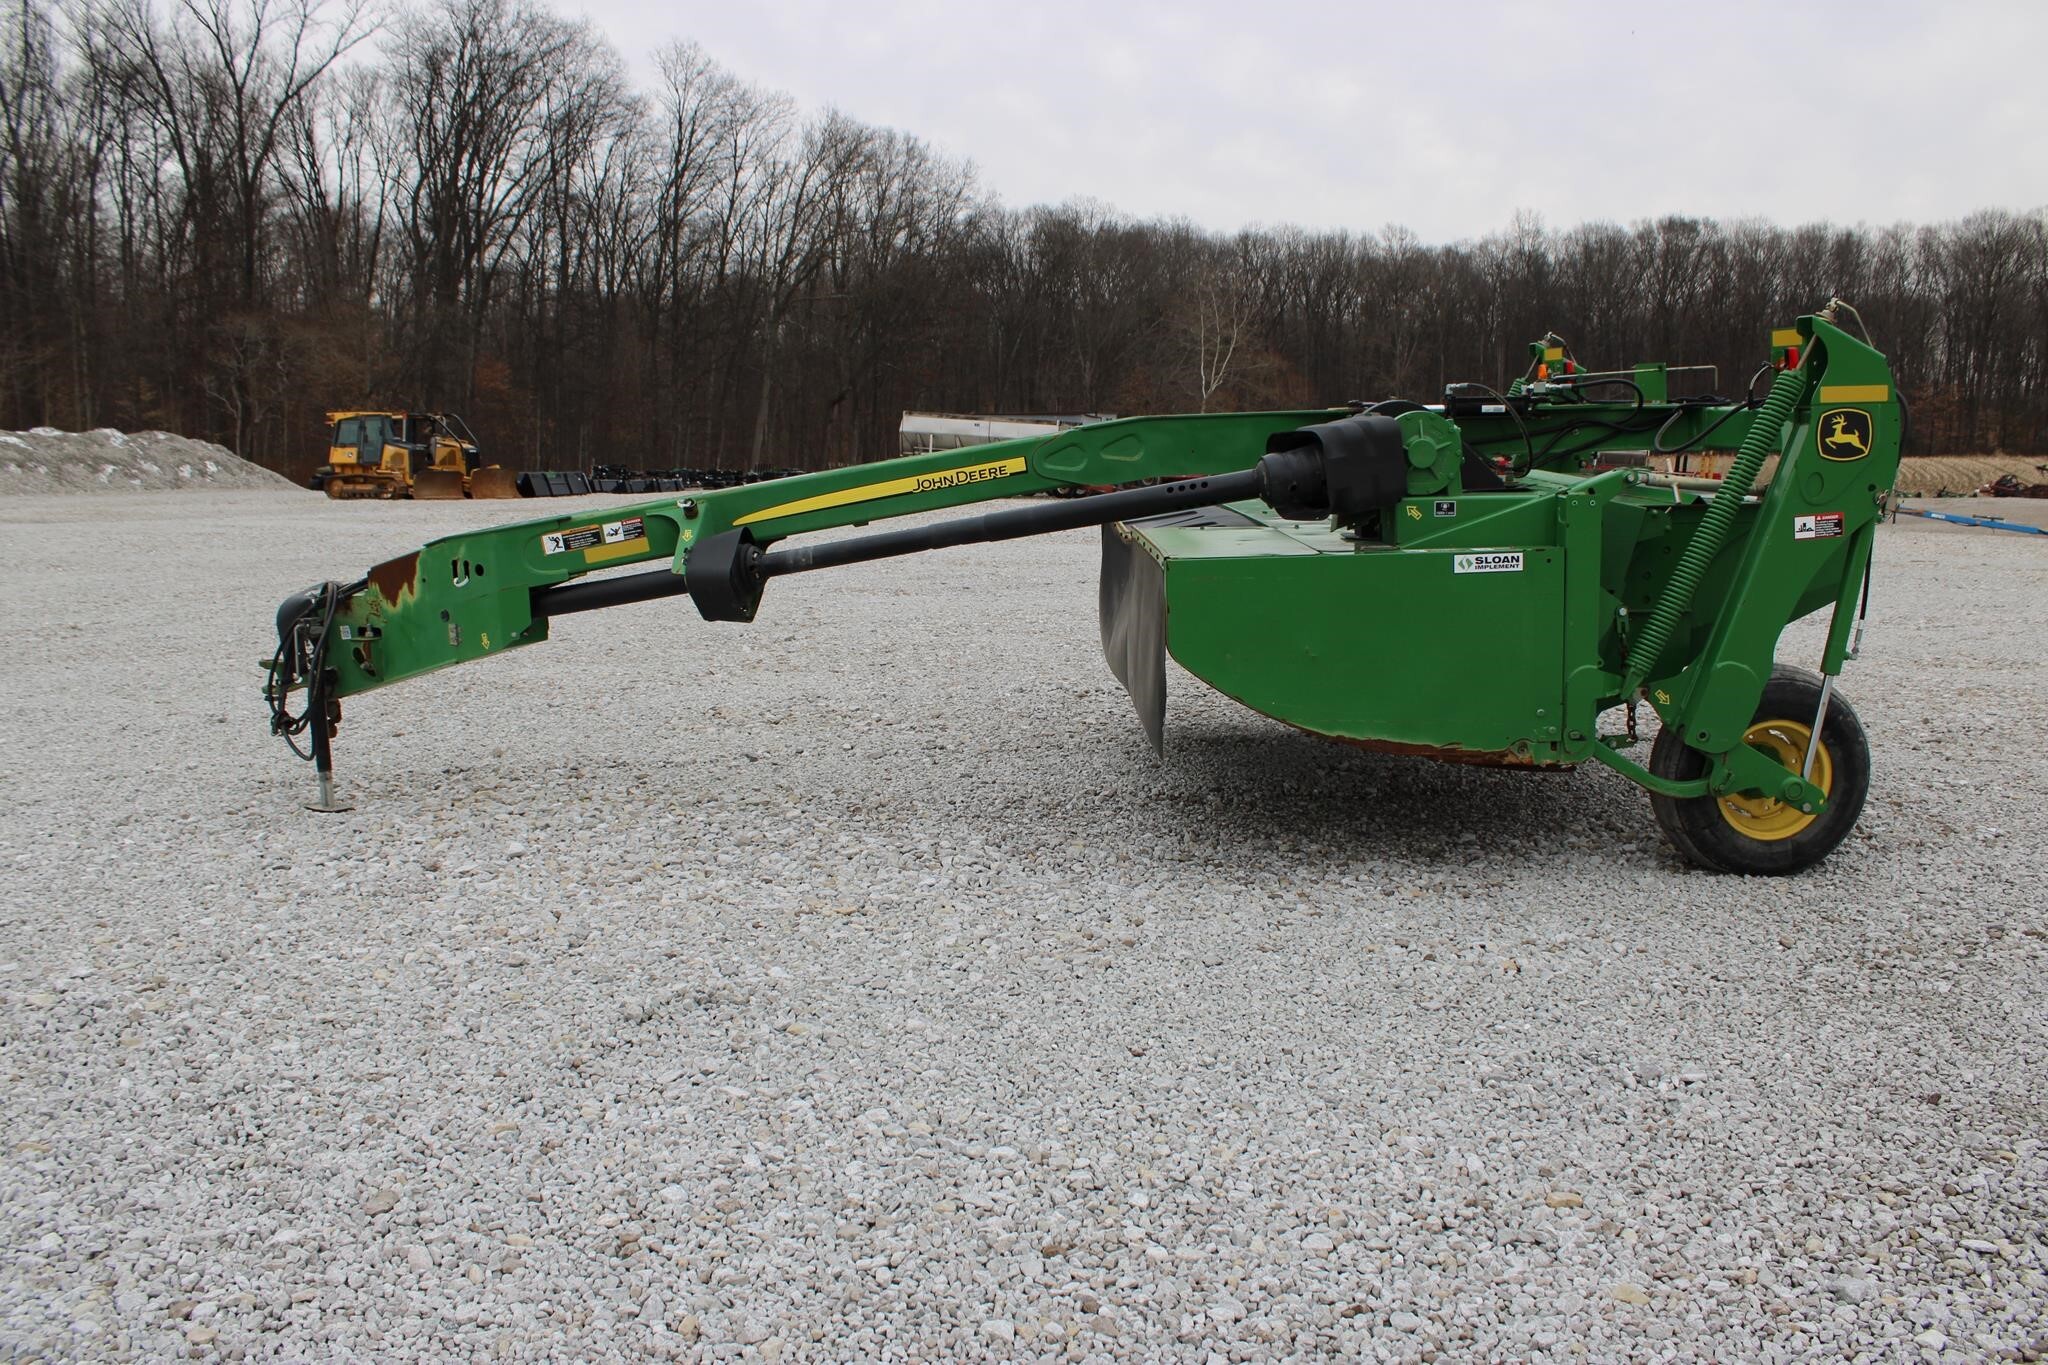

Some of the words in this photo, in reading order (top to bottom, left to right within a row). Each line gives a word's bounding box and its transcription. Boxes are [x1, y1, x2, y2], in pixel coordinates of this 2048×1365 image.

[912, 475, 954, 492] JOHN
[956, 465, 1008, 483] DEERE
[1475, 555, 1520, 565] SLOAN
